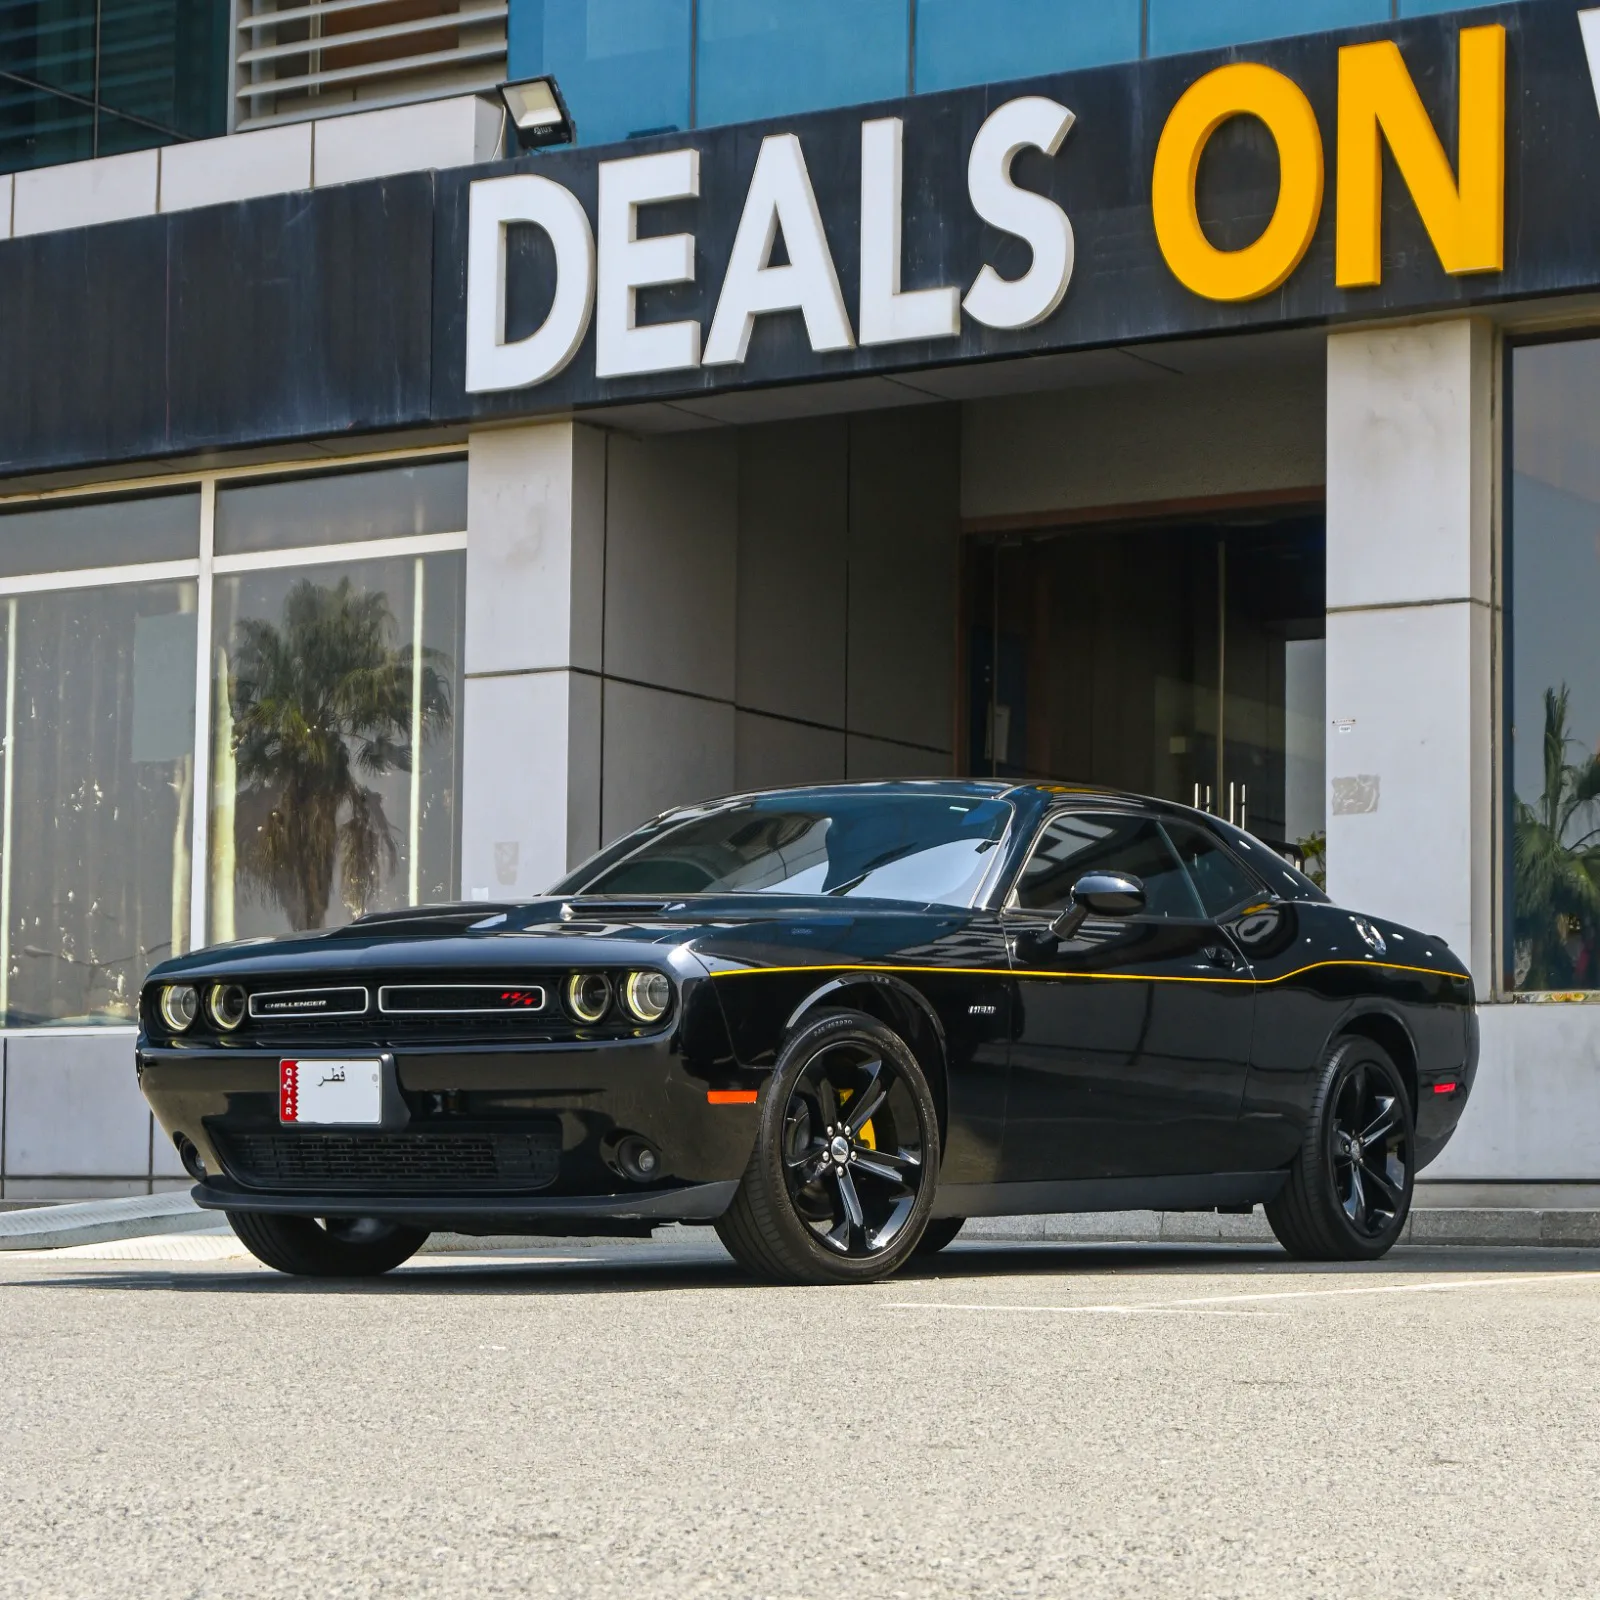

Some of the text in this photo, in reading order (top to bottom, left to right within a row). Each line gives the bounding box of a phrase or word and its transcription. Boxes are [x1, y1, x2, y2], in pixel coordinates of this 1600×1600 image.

[465, 24, 1506, 393] DEALS ON
[264, 1000, 327, 1009] CHALLENGER
[285, 1067, 293, 1116] QATAR
